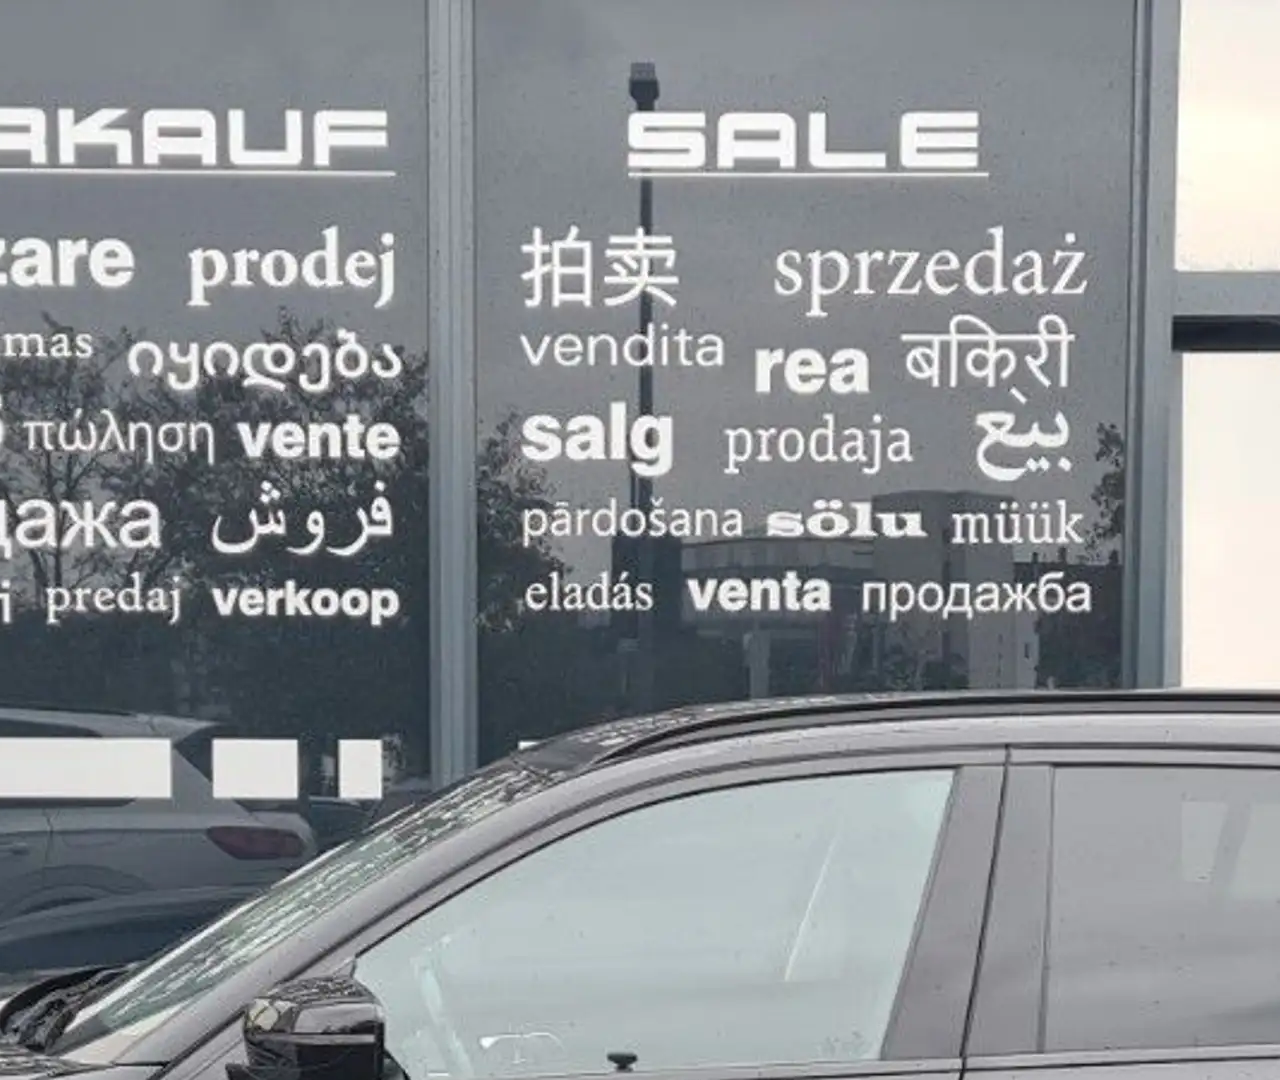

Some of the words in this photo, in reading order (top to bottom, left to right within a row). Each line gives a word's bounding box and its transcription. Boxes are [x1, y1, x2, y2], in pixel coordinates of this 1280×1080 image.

[627, 111, 979, 169] SALE
[187, 226, 394, 309] prodej
[520, 225, 679, 308] 拍卖
[774, 225, 1088, 318] sprzedaż
[127, 328, 402, 392] იყიდება
[519, 323, 724, 367] vendita
[755, 348, 870, 394] rea
[23, 408, 214, 464] πώληση
[237, 418, 400, 460] vente
[521, 401, 673, 477] salg
[723, 413, 914, 475] prodaja
[975, 411, 1072, 482] بيع
[523, 497, 743, 547] pārdošana
[766, 499, 927, 537] sölu
[952, 499, 1084, 544] müük
[46, 571, 180, 624] predaj
[212, 580, 399, 626] verkoop
[526, 571, 653, 610] eladás
[687, 571, 830, 611] venta
[863, 571, 1091, 621] продажба
